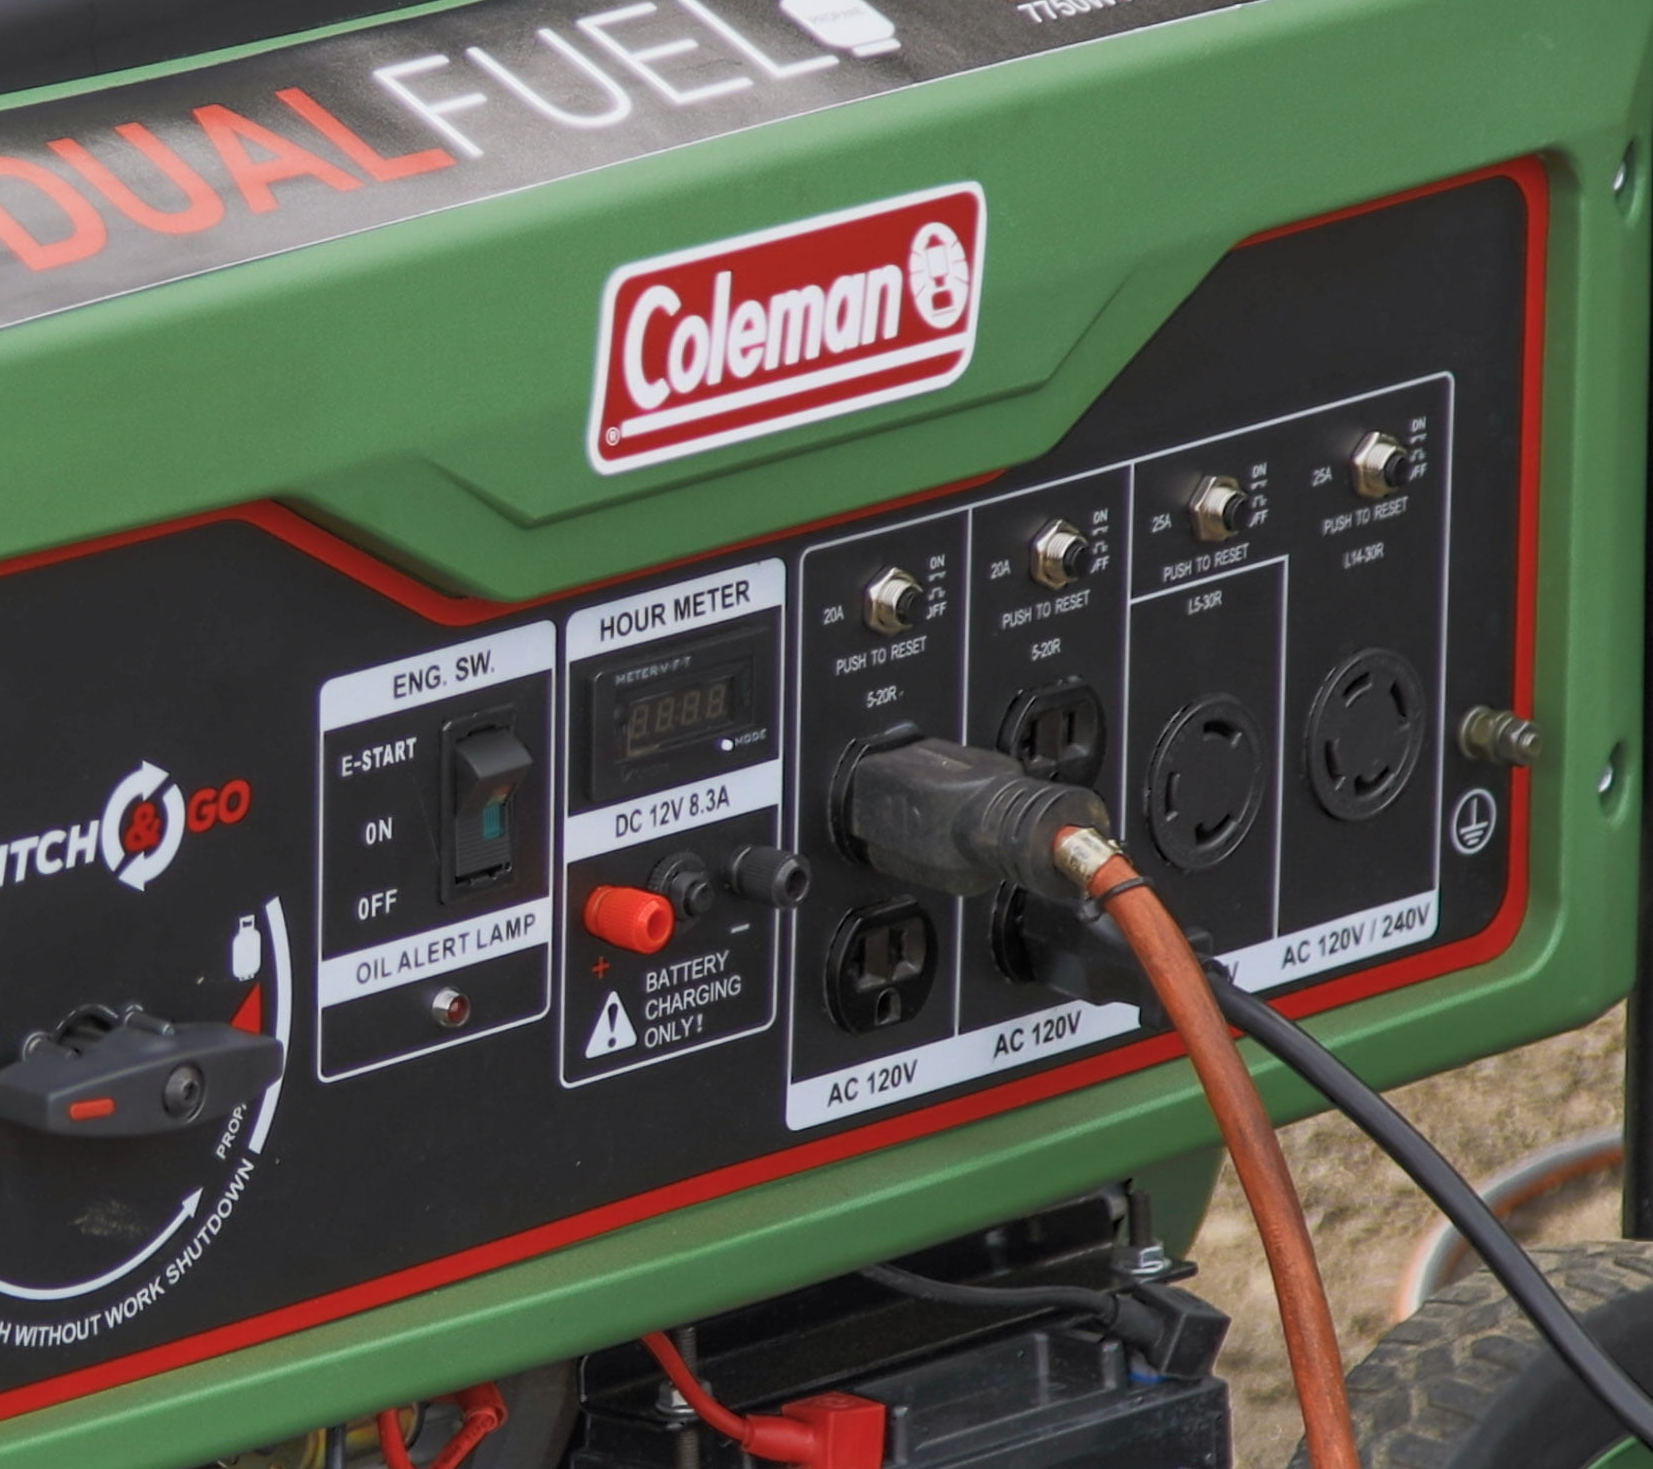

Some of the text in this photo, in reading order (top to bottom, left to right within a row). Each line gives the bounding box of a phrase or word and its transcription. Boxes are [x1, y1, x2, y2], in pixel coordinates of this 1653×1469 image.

[623, 264, 903, 410] Coleman
[1412, 416, 1426, 432] ON
[1252, 462, 1267, 478] ON
[1312, 466, 1333, 487] 25A
[1093, 509, 1108, 524] ON
[1151, 513, 1172, 533] 25A
[1322, 496, 1409, 536] PUSH TO RESET
[929, 554, 946, 570] ON
[991, 560, 1011, 579] 20A
[1163, 542, 1250, 582] PUSH TO RESET
[1344, 542, 1384, 569] L14-30R
[600, 580, 751, 642] HOUR METER
[823, 605, 844, 625] 20A
[1002, 589, 1091, 630] PUSH TO RESET
[1188, 590, 1223, 615] L5-30R
[835, 635, 927, 676] PUSH TO RESET
[1032, 638, 1061, 661] 5-20R
[393, 650, 495, 700] ENG. SW.
[867, 686, 897, 708] 5-20R
[342, 737, 417, 777] E-START
[124, 801, 162, 853] &
[186, 778, 251, 834] GO
[365, 817, 393, 845] ON
[615, 785, 730, 837] DC 12V 8.3A
[358, 889, 397, 920] OFF
[356, 914, 537, 985] OIL ALERT LAMP
[1281, 941, 1310, 969] AC
[1318, 923, 1365, 956] 120V
[1383, 902, 1430, 938] 240V
[646, 950, 730, 993] BATTERY
[645, 975, 742, 1021] CHARGING
[993, 1010, 1082, 1059] AC 120V
[827, 1059, 918, 1108] AC 120V
[15, 1313, 102, 1347] WITHOUT
[104, 1276, 166, 1330] WORK
[166, 1158, 255, 1285] SHUTDOWN
